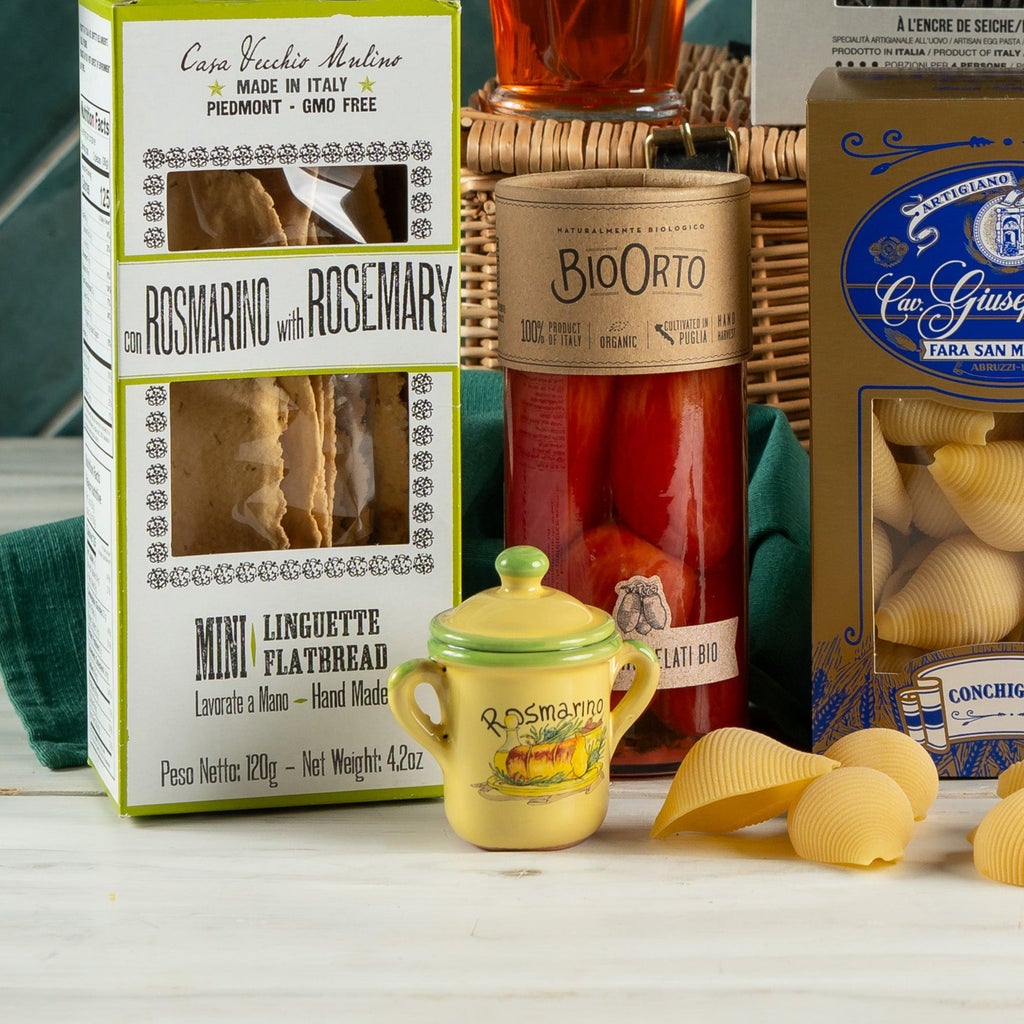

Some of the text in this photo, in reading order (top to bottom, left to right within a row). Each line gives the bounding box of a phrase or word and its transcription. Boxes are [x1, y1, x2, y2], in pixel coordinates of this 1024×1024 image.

[908, 18, 954, 33] L'ENCRE
[957, 19, 971, 32] DE
[953, 37, 982, 45] ARTISAN
[180, 42, 232, 74] Casa
[239, 34, 310, 72] Vecchio
[832, 48, 882, 56] PRODOTTO
[884, 48, 893, 56] IN
[895, 48, 926, 56] ITALIA
[933, 49, 976, 57] PRODUCT
[979, 49, 992, 57] OF
[994, 49, 1021, 57] ITALY
[236, 76, 348, 94] MADE IN ITALY
[206, 97, 377, 117] PIEDMONT GMO FREE
[922, 174, 1008, 214] ARTIGIANO
[557, 224, 705, 234] NATURALMENTE BIOLOGICO
[124, 330, 142, 355] con
[146, 277, 270, 356] ROSMARINO
[276, 308, 304, 342] with
[308, 261, 453, 338] ROSEMARY
[875, 272, 924, 326] Cav.
[664, 318, 709, 331] CULTIVATED IN
[717, 312, 736, 327] HAND
[520, 319, 581, 344] 100% PRODUCT
[549, 335, 582, 347] OF ITALY
[600, 336, 638, 348] ORGANIC
[680, 330, 707, 345] PUGLIA
[929, 343, 971, 358] FARA
[974, 343, 1011, 357] SAN
[263, 609, 380, 641] LINGUETTE
[195, 614, 247, 681] MINI
[698, 641, 718, 665] BIO
[263, 643, 388, 677] FLATBREAD
[195, 679, 389, 717] Lavorate a Mano Hand Made
[480, 698, 604, 737] Rosmarino
[160, 745, 425, 788] Peso Netto: 120g Net Weight: 4.2oz
